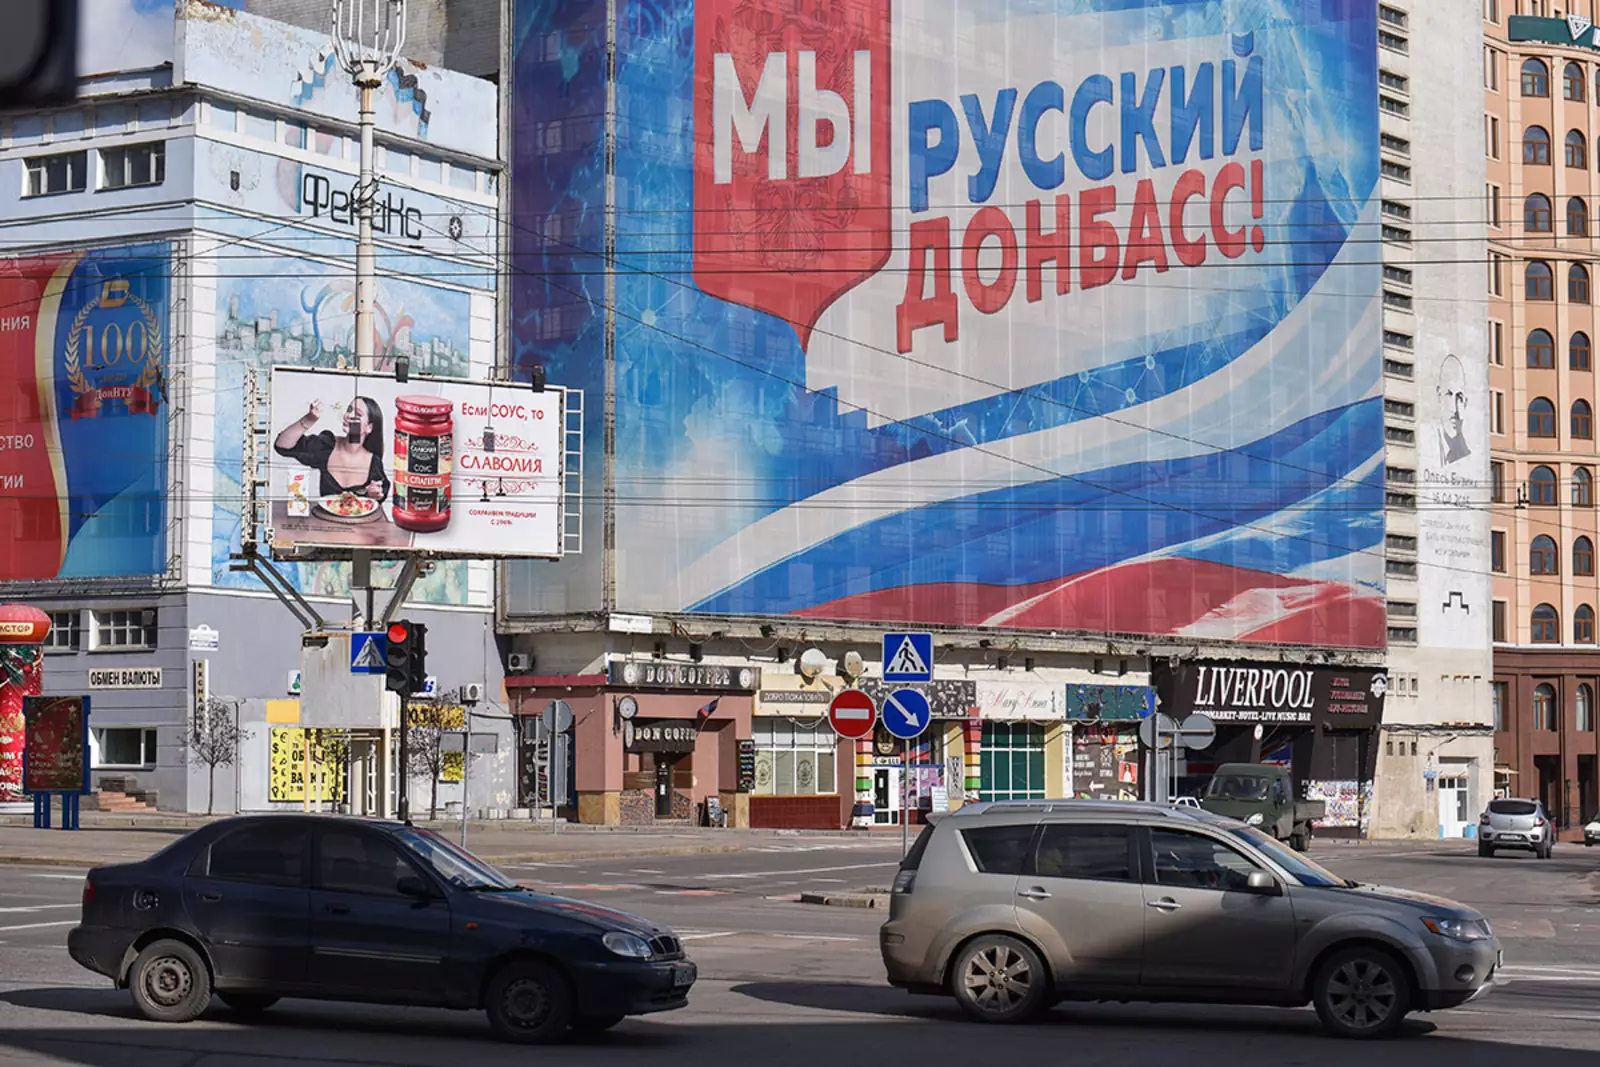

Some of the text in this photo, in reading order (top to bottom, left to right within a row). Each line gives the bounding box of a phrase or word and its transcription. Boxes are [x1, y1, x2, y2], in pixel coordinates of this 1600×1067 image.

[712, 49, 871, 185] МЫ
[908, 30, 1264, 214] РУССКИЙ
[896, 158, 1265, 354] ДОНБАСС!
[1, 315, 31, 332] НИЯ
[83, 320, 147, 369] 100
[462, 402, 488, 417] Если
[491, 403, 529, 421] СОУС,
[460, 454, 543, 474] СЛАВОЛИЯ
[90, 671, 161, 686] ОБМЕН ВАЛЮТЫ
[646, 666, 730, 685] DON COFFEE
[1194, 666, 1316, 709] LIVERPOOL
[635, 727, 661, 741] DON
